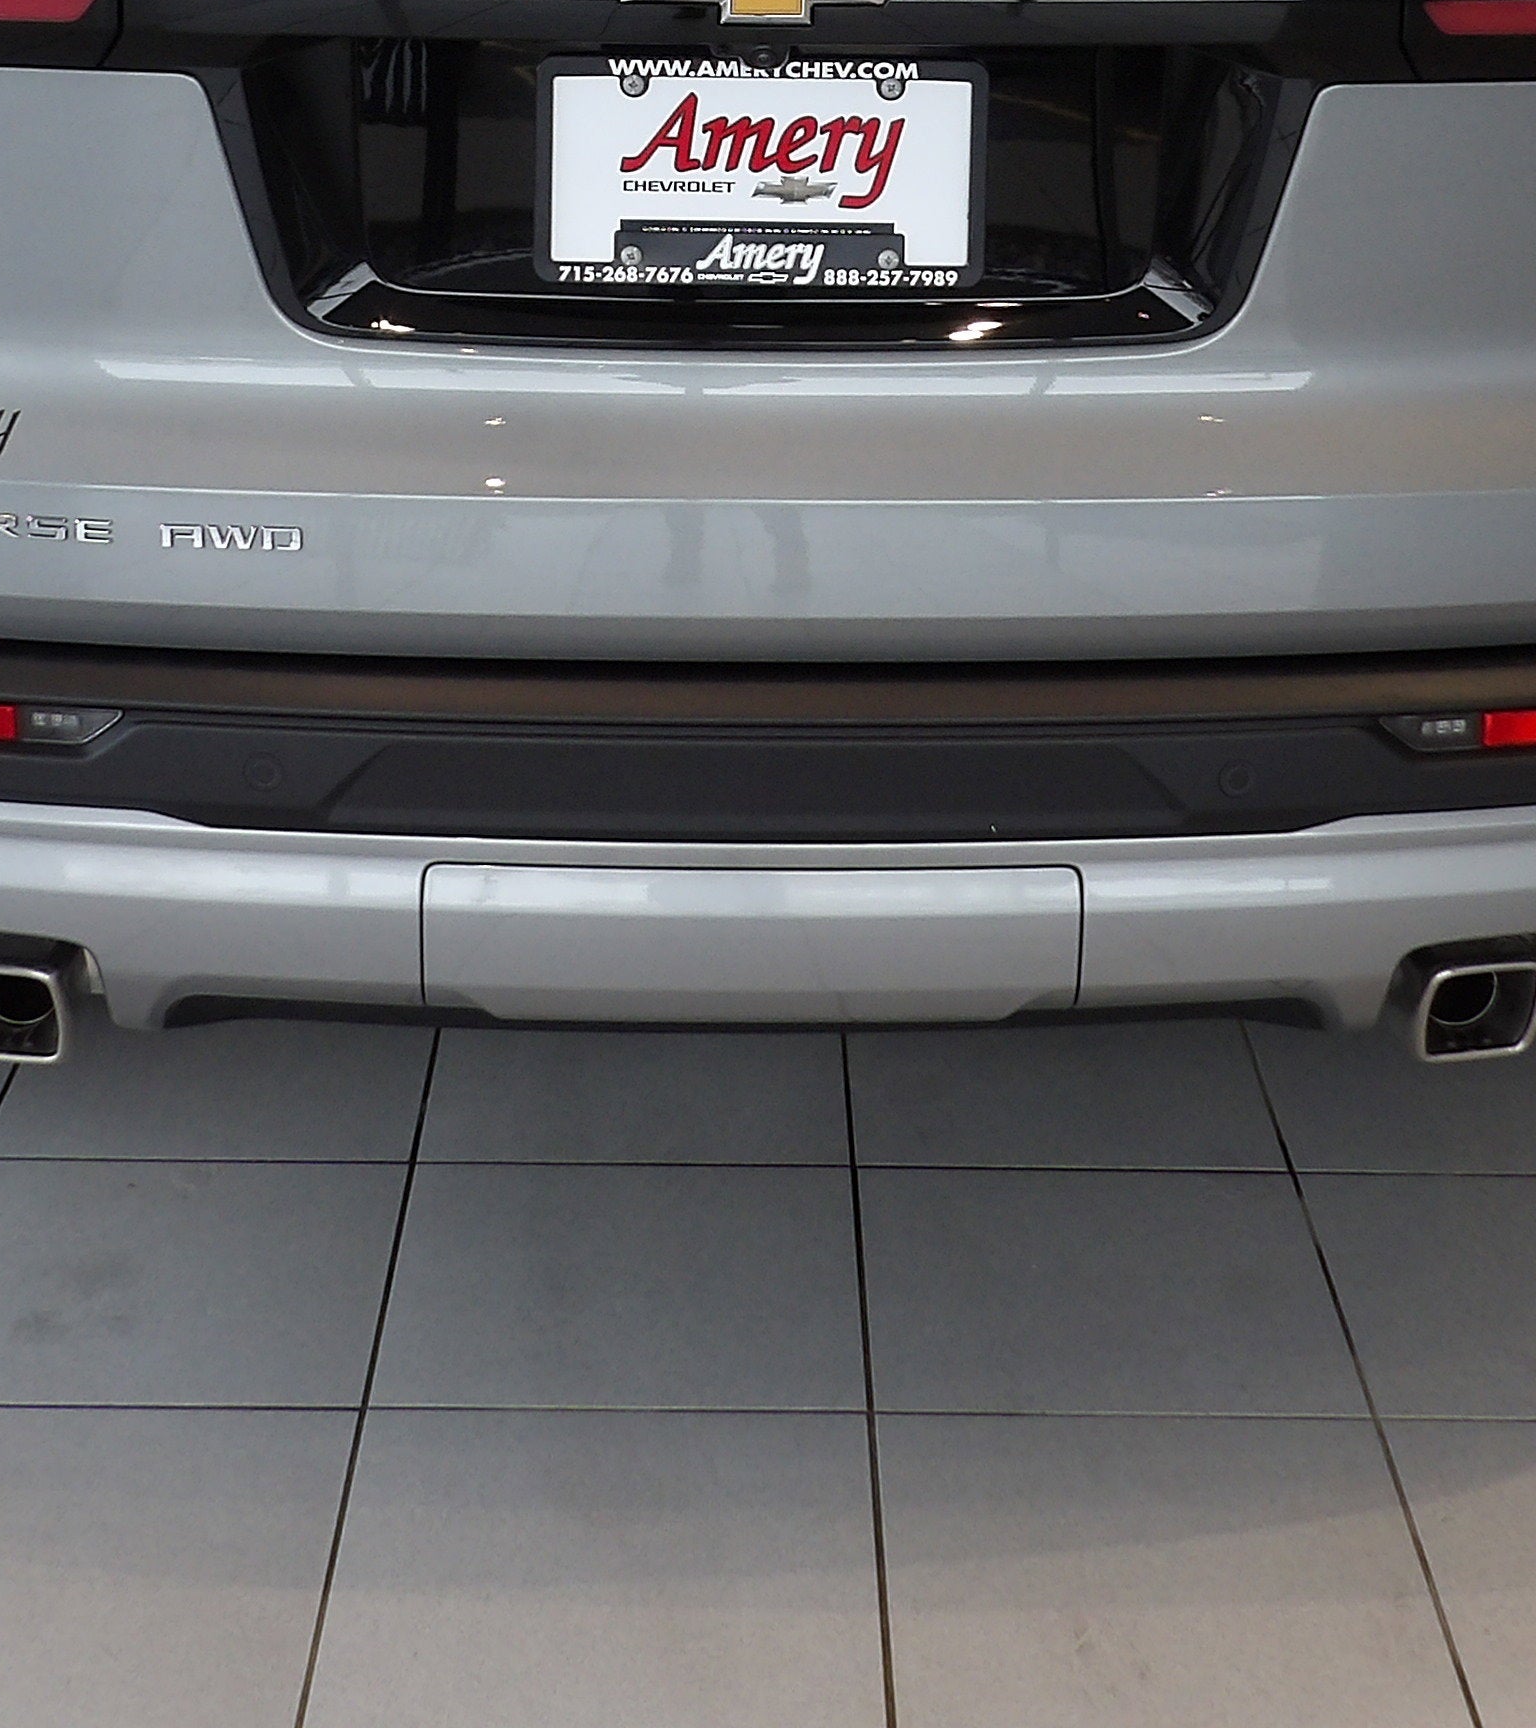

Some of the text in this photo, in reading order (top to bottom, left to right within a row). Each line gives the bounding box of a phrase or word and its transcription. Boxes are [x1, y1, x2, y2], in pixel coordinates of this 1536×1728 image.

[620, 91, 906, 209] Amery
[622, 179, 737, 194] CHEVROLET
[695, 232, 825, 284] Amery
[558, 265, 694, 284] 715-268-7676
[822, 269, 959, 287] 888-257-7989
[159, 522, 304, 552] AWD
